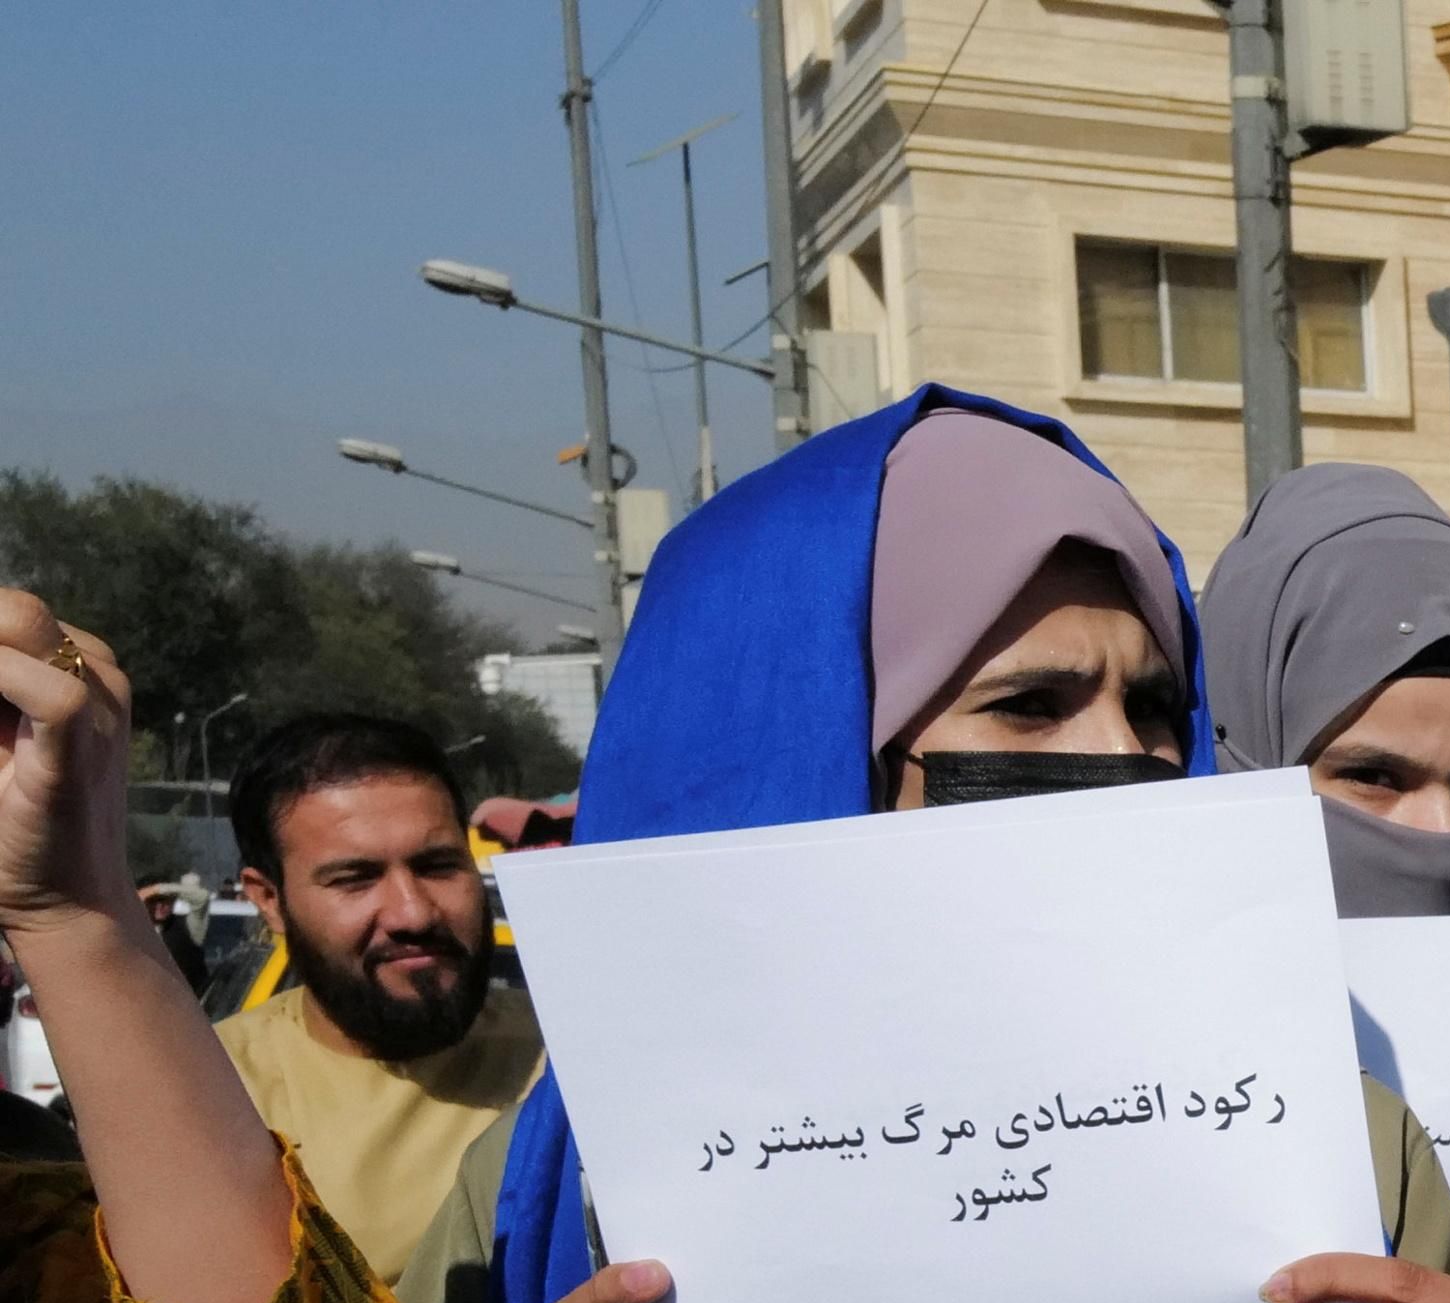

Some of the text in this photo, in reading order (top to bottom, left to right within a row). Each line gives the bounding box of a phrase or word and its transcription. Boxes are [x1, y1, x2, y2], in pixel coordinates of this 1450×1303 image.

[698, 1073, 1286, 1172] رکود اقتصادی مرگ بیشتر در
[951, 1163, 1052, 1222] کشور
